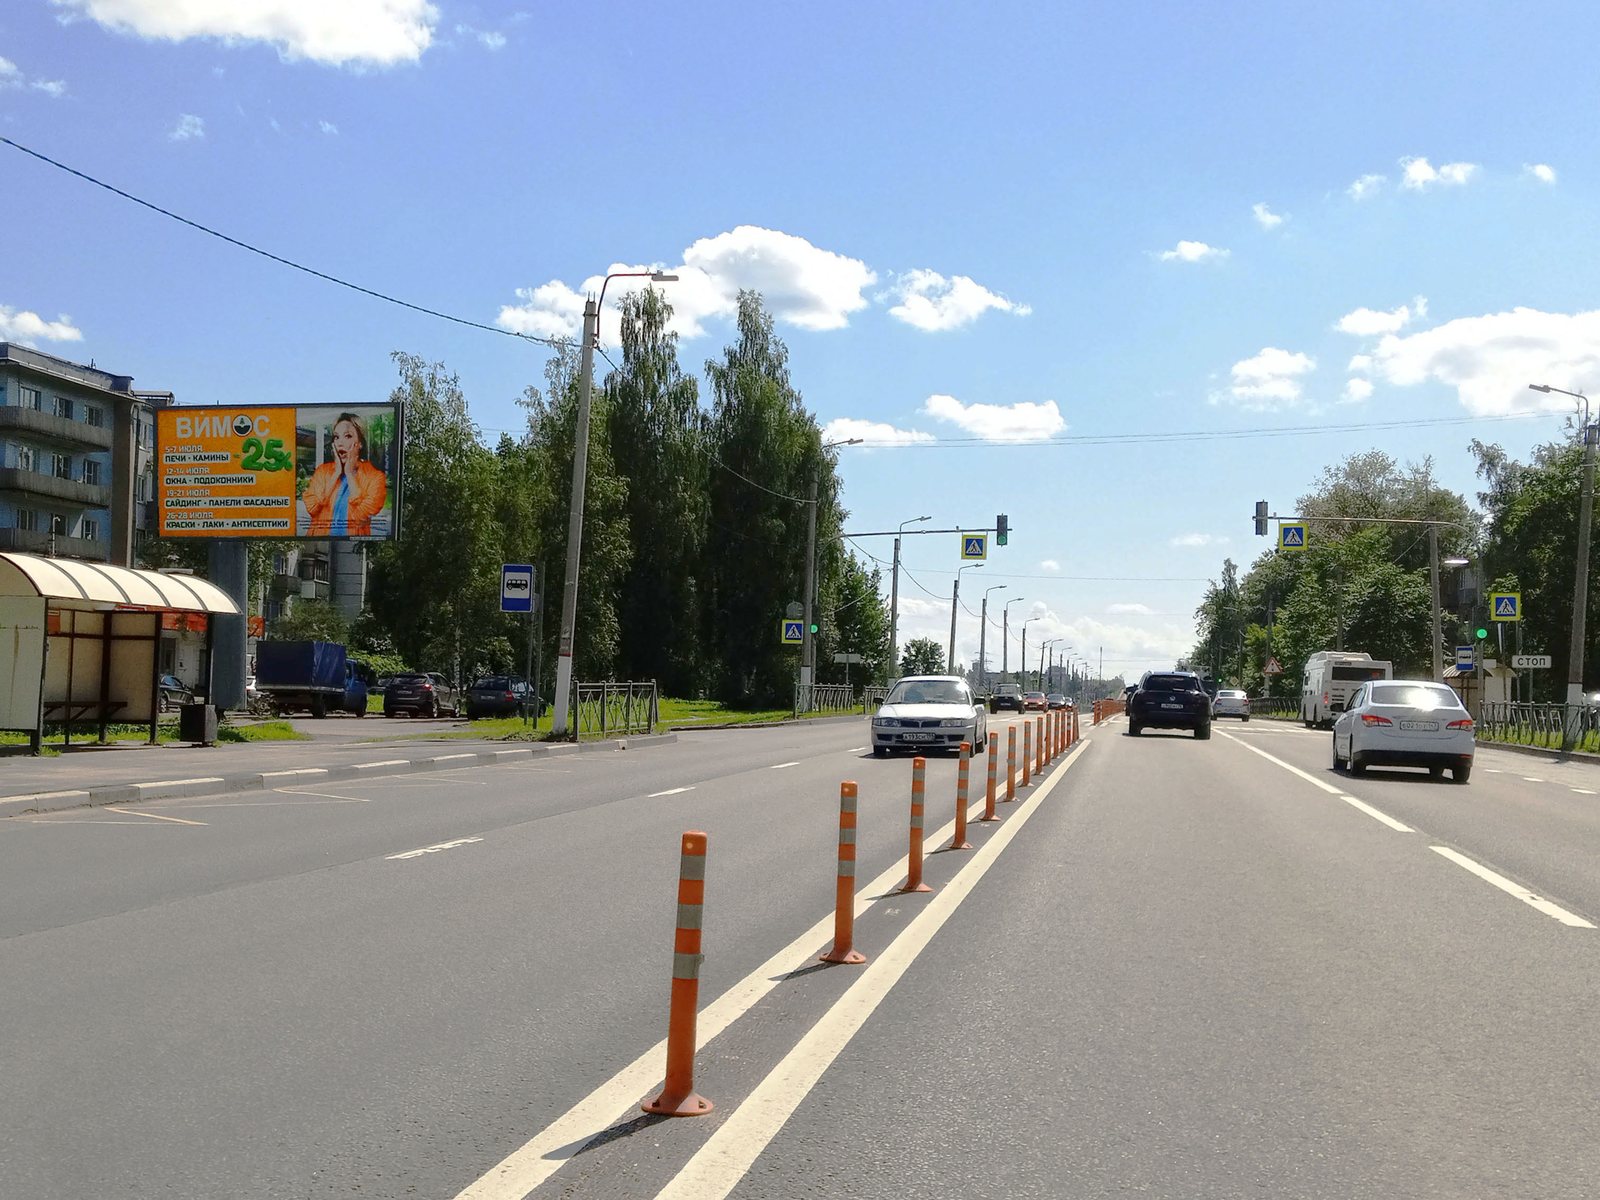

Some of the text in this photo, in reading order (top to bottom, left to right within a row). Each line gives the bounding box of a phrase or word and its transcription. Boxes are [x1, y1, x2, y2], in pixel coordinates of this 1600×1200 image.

[165, 453, 229, 462] ПЕЧИ КАМИНЫ
[165, 476, 254, 485] ОКНА ПОДОКОННИКИ
[167, 489, 185, 497] 19-21
[165, 498, 289, 507] САЙДИНГ ПАНЕЛИ ФАСАДНЫЕ
[190, 511, 214, 519] ИЮЛЯ
[166, 521, 196, 529] КРАСКИ
[202, 520, 225, 528] ЛАКИ
[231, 519, 288, 528] АНТИСЕПТИКИ
[1517, 657, 1546, 666] СТОП
